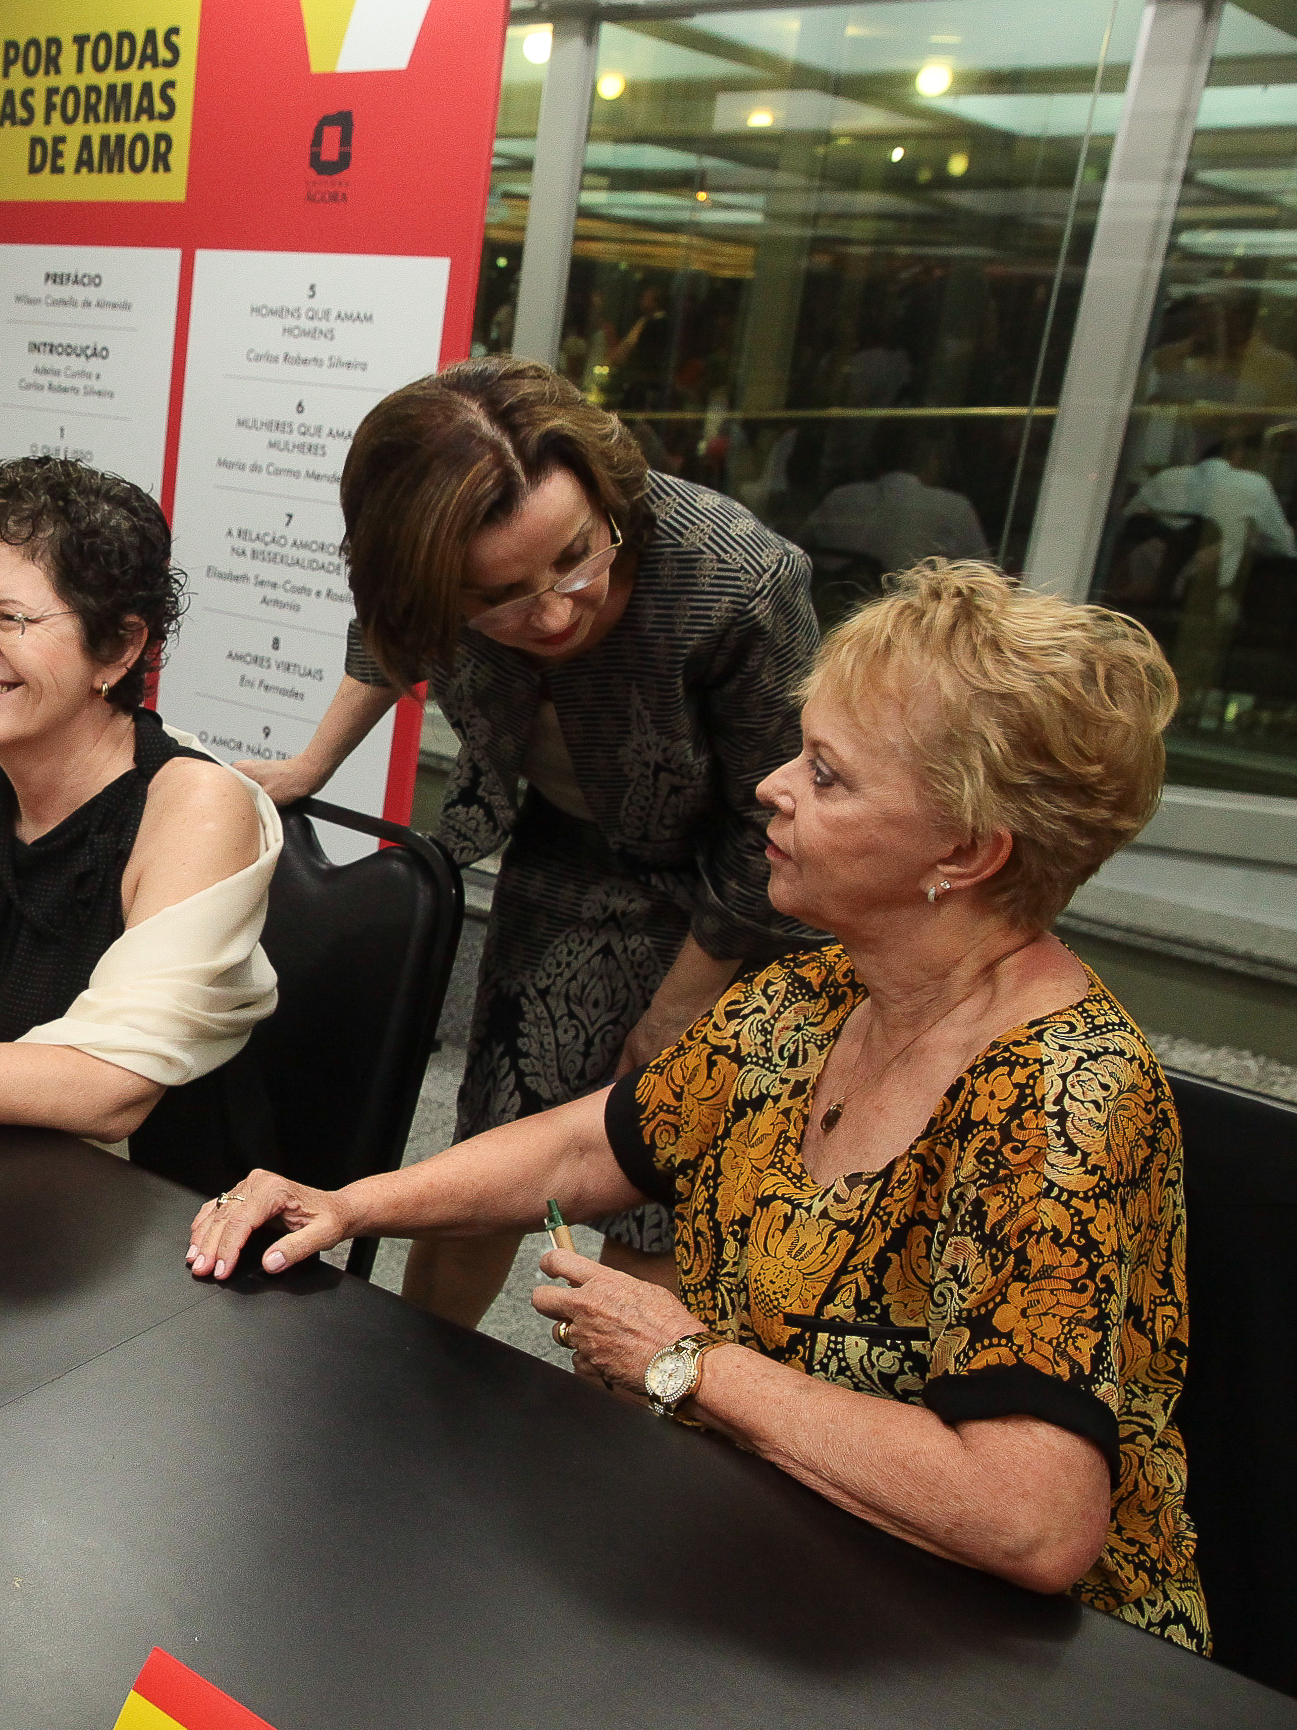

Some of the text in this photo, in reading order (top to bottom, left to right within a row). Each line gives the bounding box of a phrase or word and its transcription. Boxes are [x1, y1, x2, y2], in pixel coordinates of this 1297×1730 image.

[2, 27, 181, 79] POR TODAS
[44, 80, 177, 126] FORMAS
[27, 132, 172, 175] DE AMOR
[44, 269, 103, 288] PREFÁCIO
[307, 283, 316, 299] 5
[82, 296, 92, 308] de
[250, 304, 374, 325] HOMENS QUE AMAM
[282, 325, 335, 342] HOMENS
[27, 340, 109, 362] INTRODUÇÃO
[246, 348, 368, 372] Carlos Roberto Silveira
[18, 378, 115, 399] Carlos Roberto Silveira
[296, 399, 305, 414] 6
[58, 426, 65, 439] 1
[236, 418, 354, 442] MULHERES QUE AMA
[267, 439, 327, 458] MULHERES
[216, 457, 341, 484] Maria do Carmo Mende
[285, 513, 293, 527] 7
[225, 528, 233, 539] A
[236, 527, 288, 548] RELAÇÃO
[230, 545, 342, 576] NA BISSEXUALIDADE
[205, 564, 250, 584] Elisabeth
[260, 595, 302, 613] Antonio
[271, 636, 280, 651] 8
[226, 650, 324, 682] AMORES VIRTUAIS
[262, 726, 271, 740] 9
[198, 731, 208, 743] O
[211, 735, 243, 753] AMOR
[246, 743, 272, 760] NÃO
